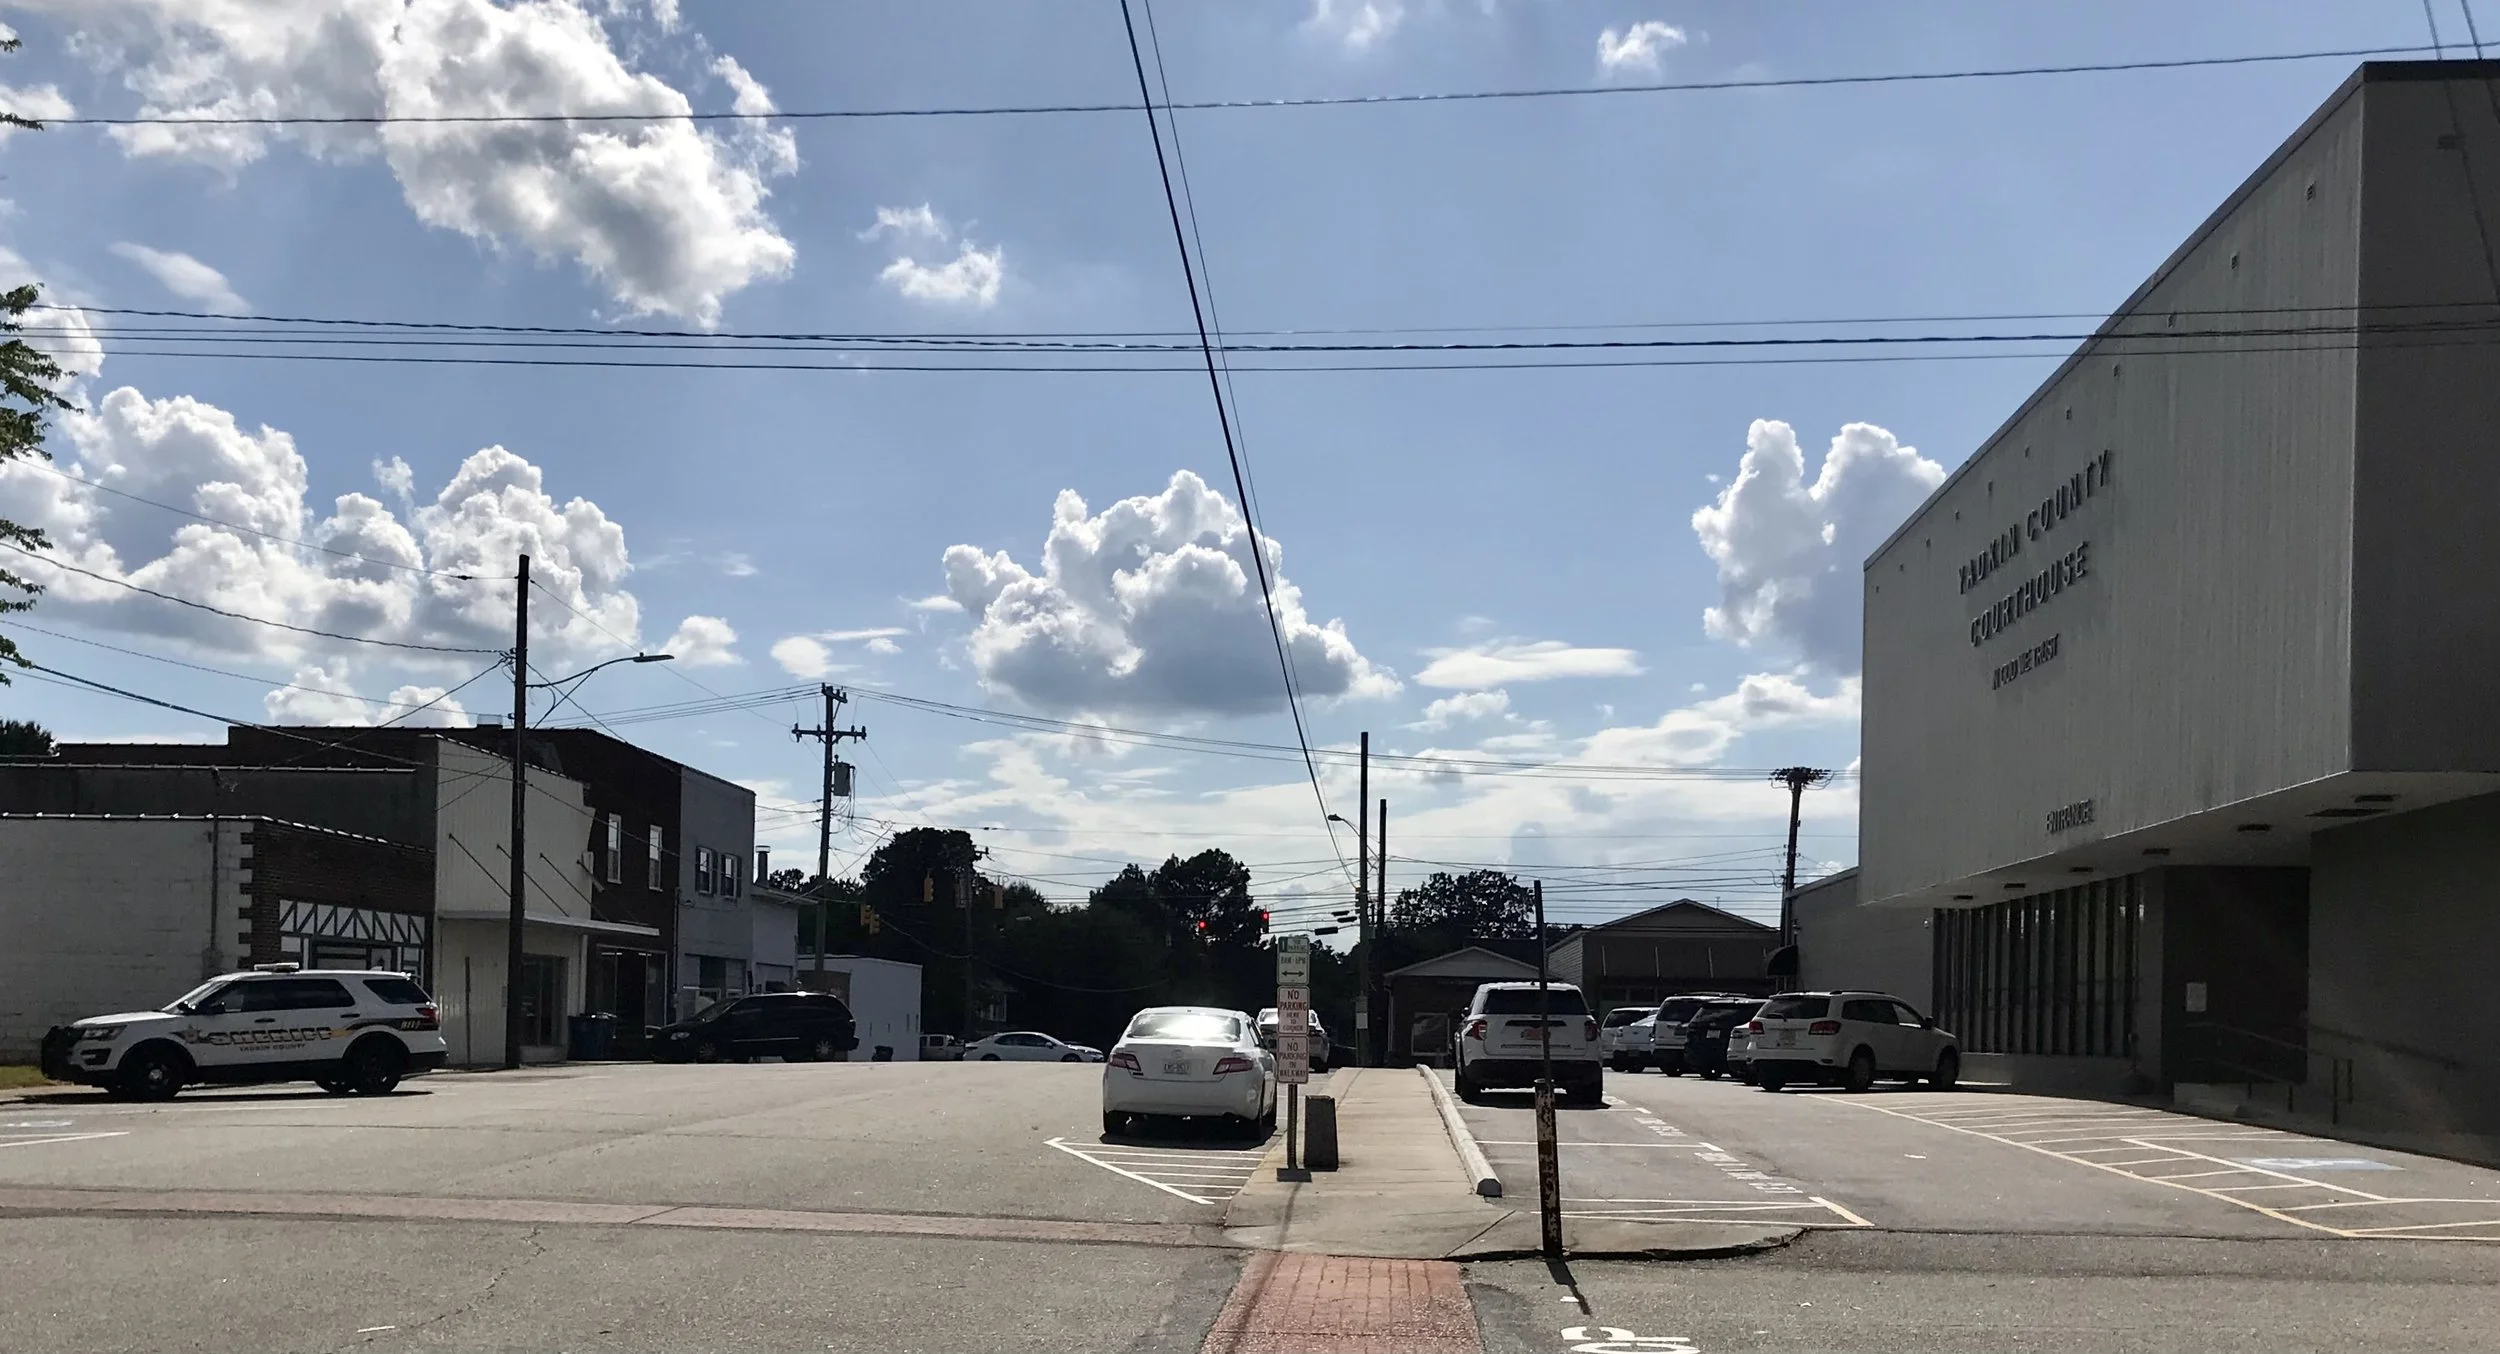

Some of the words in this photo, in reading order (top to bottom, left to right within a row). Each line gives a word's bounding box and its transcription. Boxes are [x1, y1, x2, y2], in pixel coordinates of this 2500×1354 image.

[1957, 523, 2018, 595] YADKIN
[2025, 448, 2112, 541] COUNTY
[1969, 541, 2090, 647] COURTHOUSE
[2046, 798, 2093, 833] ENTRANCE
[1287, 990, 1300, 1000] NO
[1279, 1001, 1307, 1011] PARKING
[207, 1026, 332, 1046] SHERIFF
[1286, 1041, 1299, 1052] NO
[1279, 1052, 1307, 1060] PARKING
